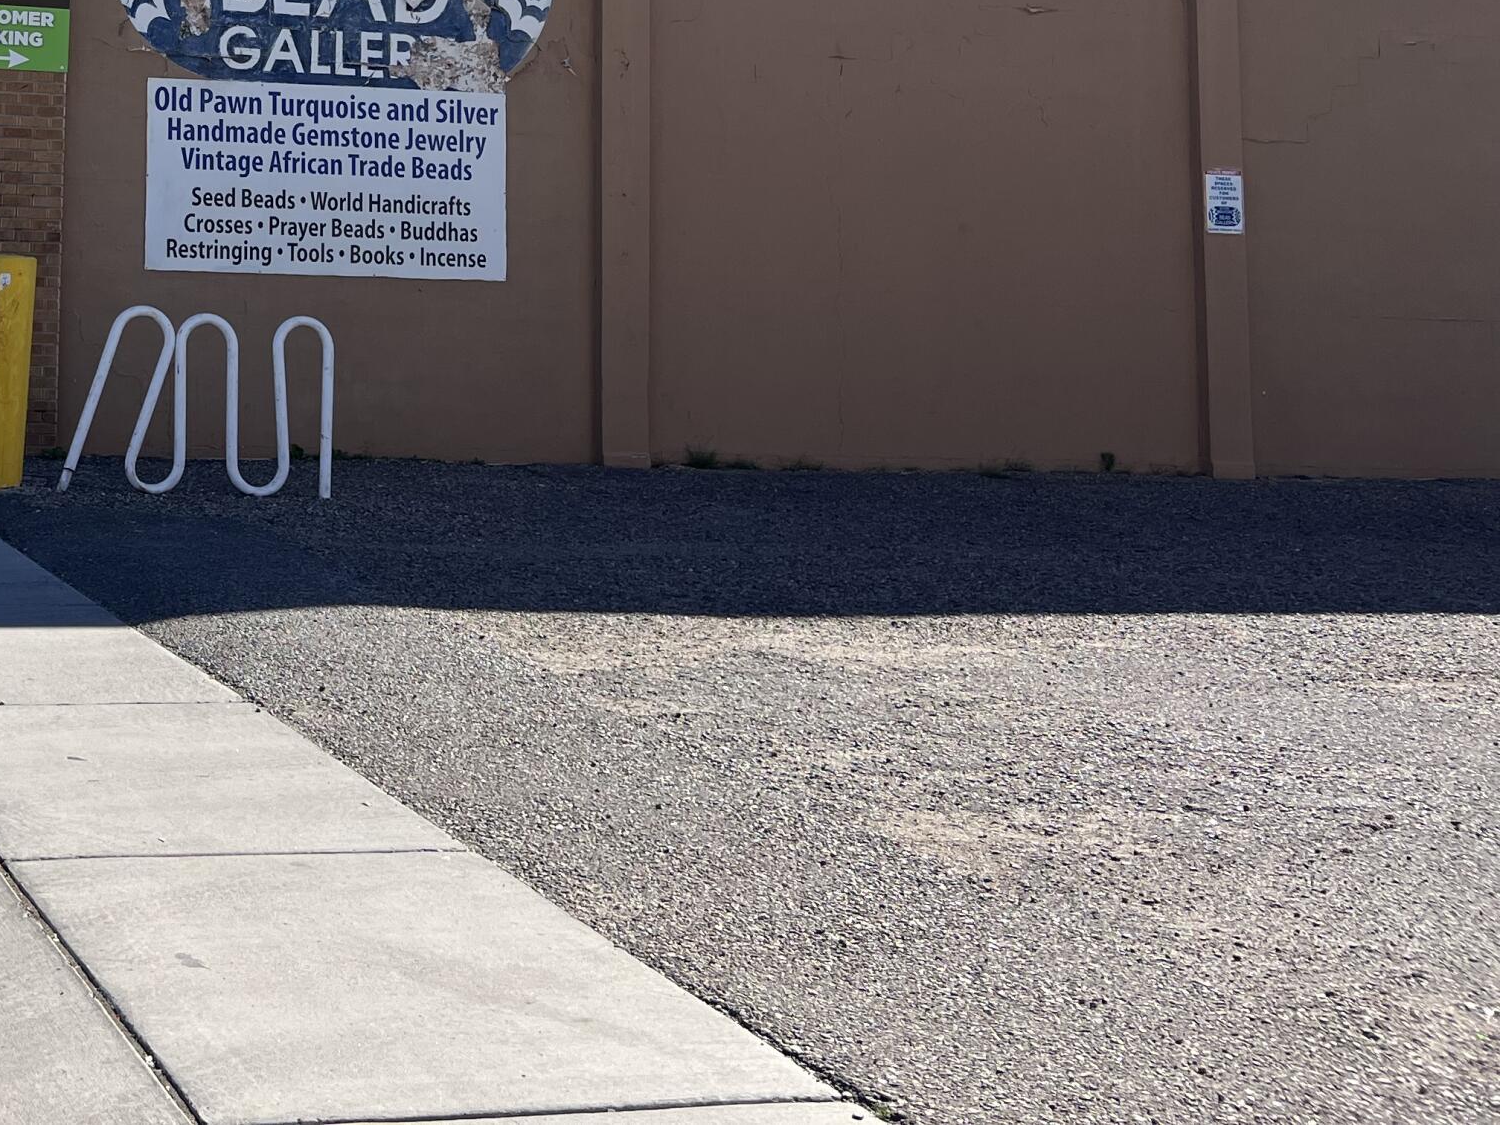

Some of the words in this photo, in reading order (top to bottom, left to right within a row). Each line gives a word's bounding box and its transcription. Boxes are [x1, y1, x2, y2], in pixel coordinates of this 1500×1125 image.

[219, 25, 428, 79] GALLER
[154, 86, 193, 113] Old
[200, 89, 263, 116] Pawn
[268, 91, 381, 124] Turquoise
[386, 98, 430, 123] and
[435, 99, 499, 125] Silver
[167, 118, 286, 145] Handmade
[291, 122, 400, 150] Gemstone
[405, 128, 487, 160] Jewelry
[181, 147, 264, 178] Vintage
[269, 151, 343, 176] African
[348, 154, 406, 179] Trade
[412, 156, 473, 181] Beads
[191, 187, 236, 208] Seed
[241, 188, 296, 210] Beads
[310, 191, 364, 213] World
[368, 193, 471, 216] Handicrafts
[184, 213, 253, 235] Crosses
[268, 216, 327, 242] Prayer
[331, 218, 385, 239] Beads
[400, 221, 478, 243] Buddhas
[166, 239, 273, 265] Restringing
[286, 242, 334, 263] Tools
[350, 245, 405, 265] Books
[420, 247, 487, 268] Incense
